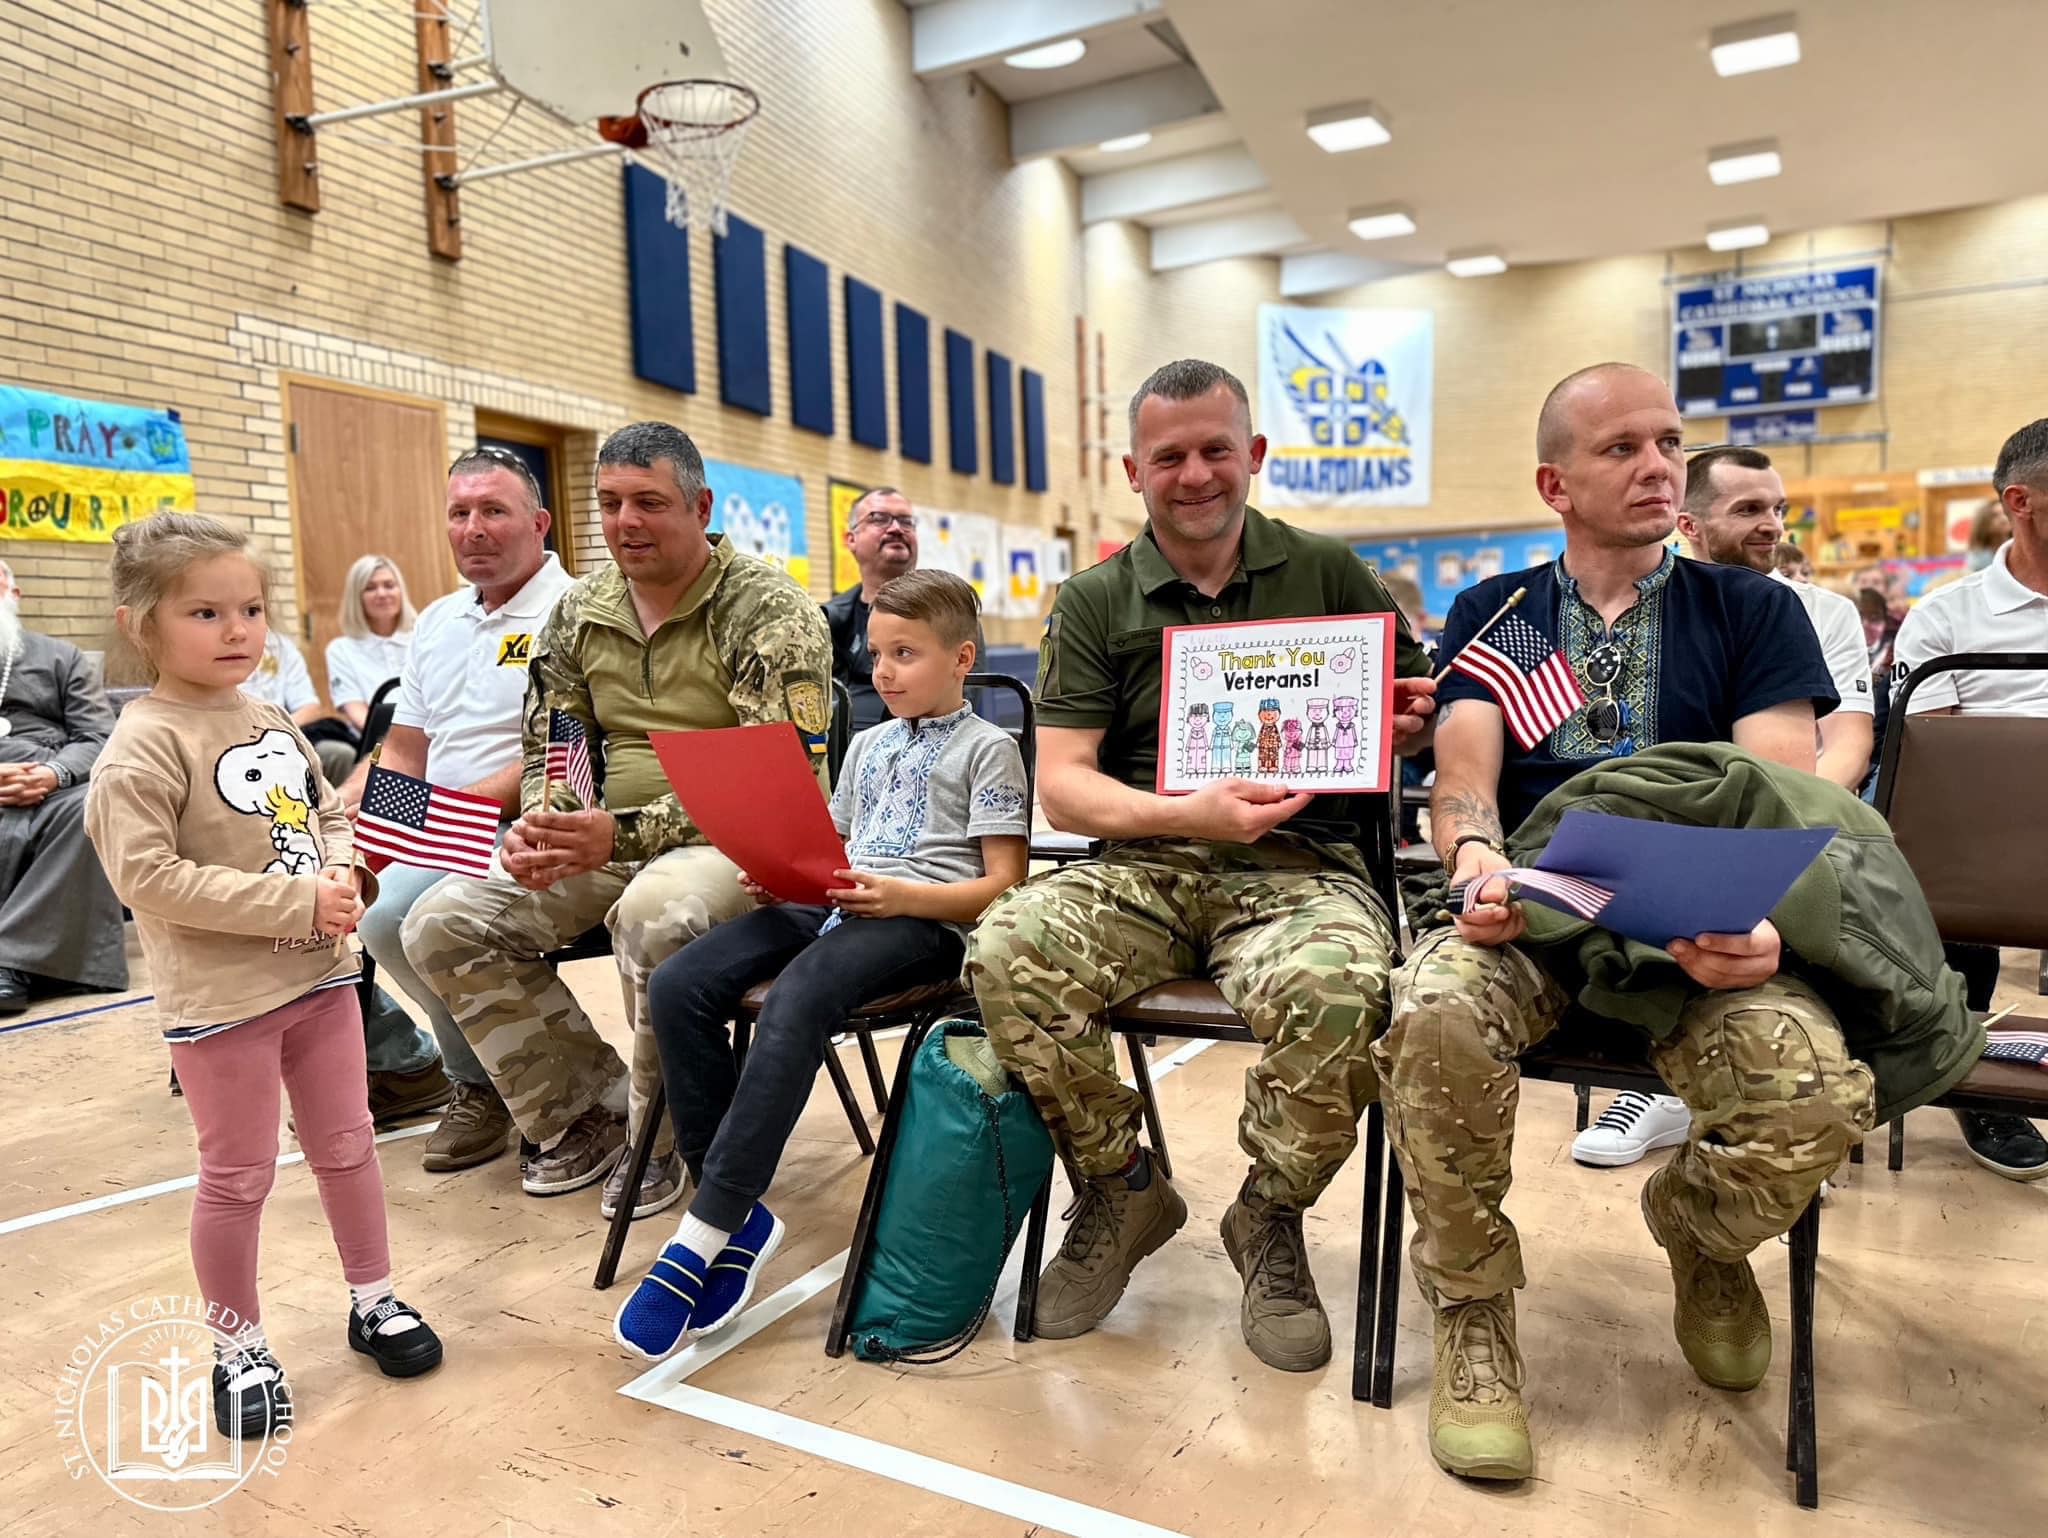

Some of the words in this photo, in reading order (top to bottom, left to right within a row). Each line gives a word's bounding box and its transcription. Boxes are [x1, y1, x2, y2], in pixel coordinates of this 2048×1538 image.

[27, 408, 120, 459] PRAY
[1269, 457, 1412, 494] GUARDIANS
[1218, 650, 1276, 671] Thank
[1286, 647, 1325, 667] You
[1224, 668, 1319, 691] Veterans!
